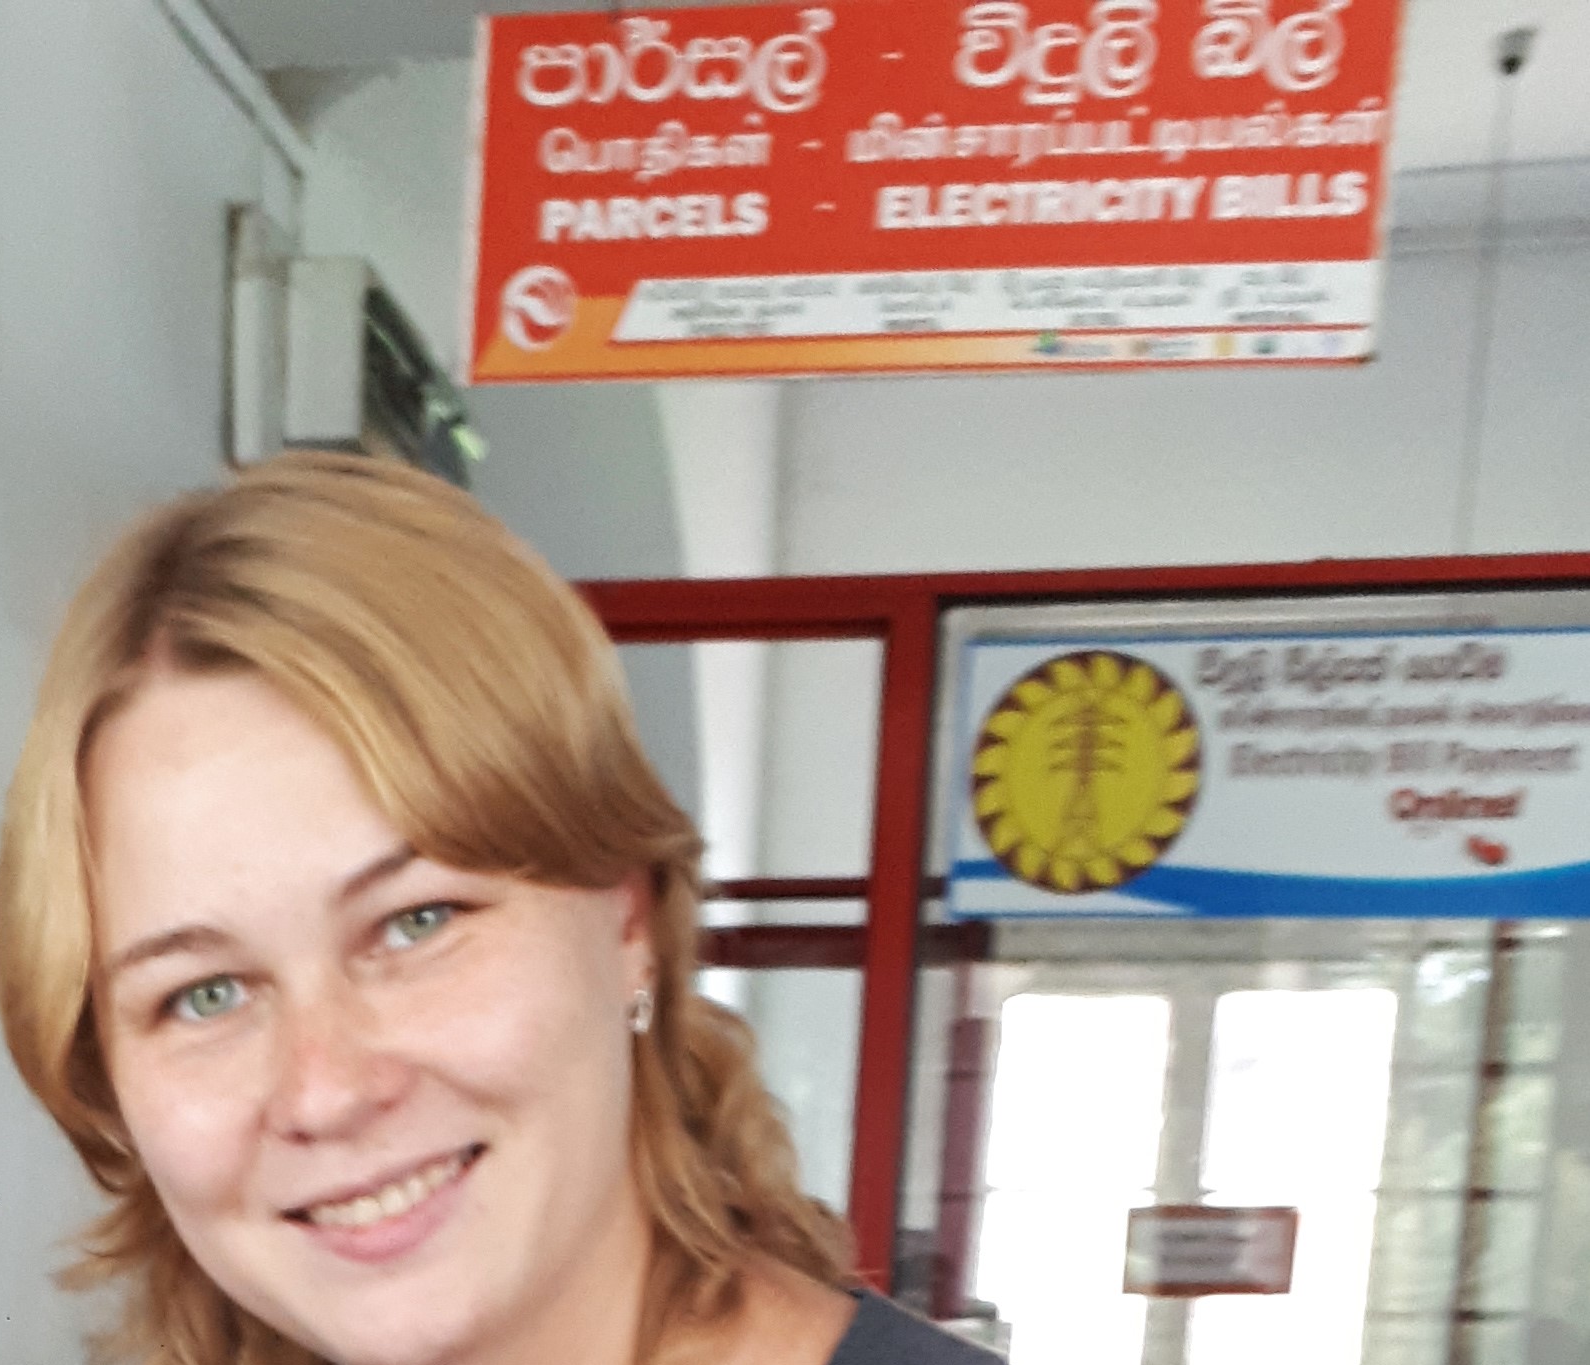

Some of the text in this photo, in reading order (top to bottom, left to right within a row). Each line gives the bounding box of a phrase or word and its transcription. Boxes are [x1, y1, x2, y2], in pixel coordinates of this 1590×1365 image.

[955, 0, 1160, 106] විදුලි
[539, 191, 770, 242] PARCELS
[875, 175, 1207, 231] ELECTRICITY
[1211, 170, 1369, 221] BILLS
